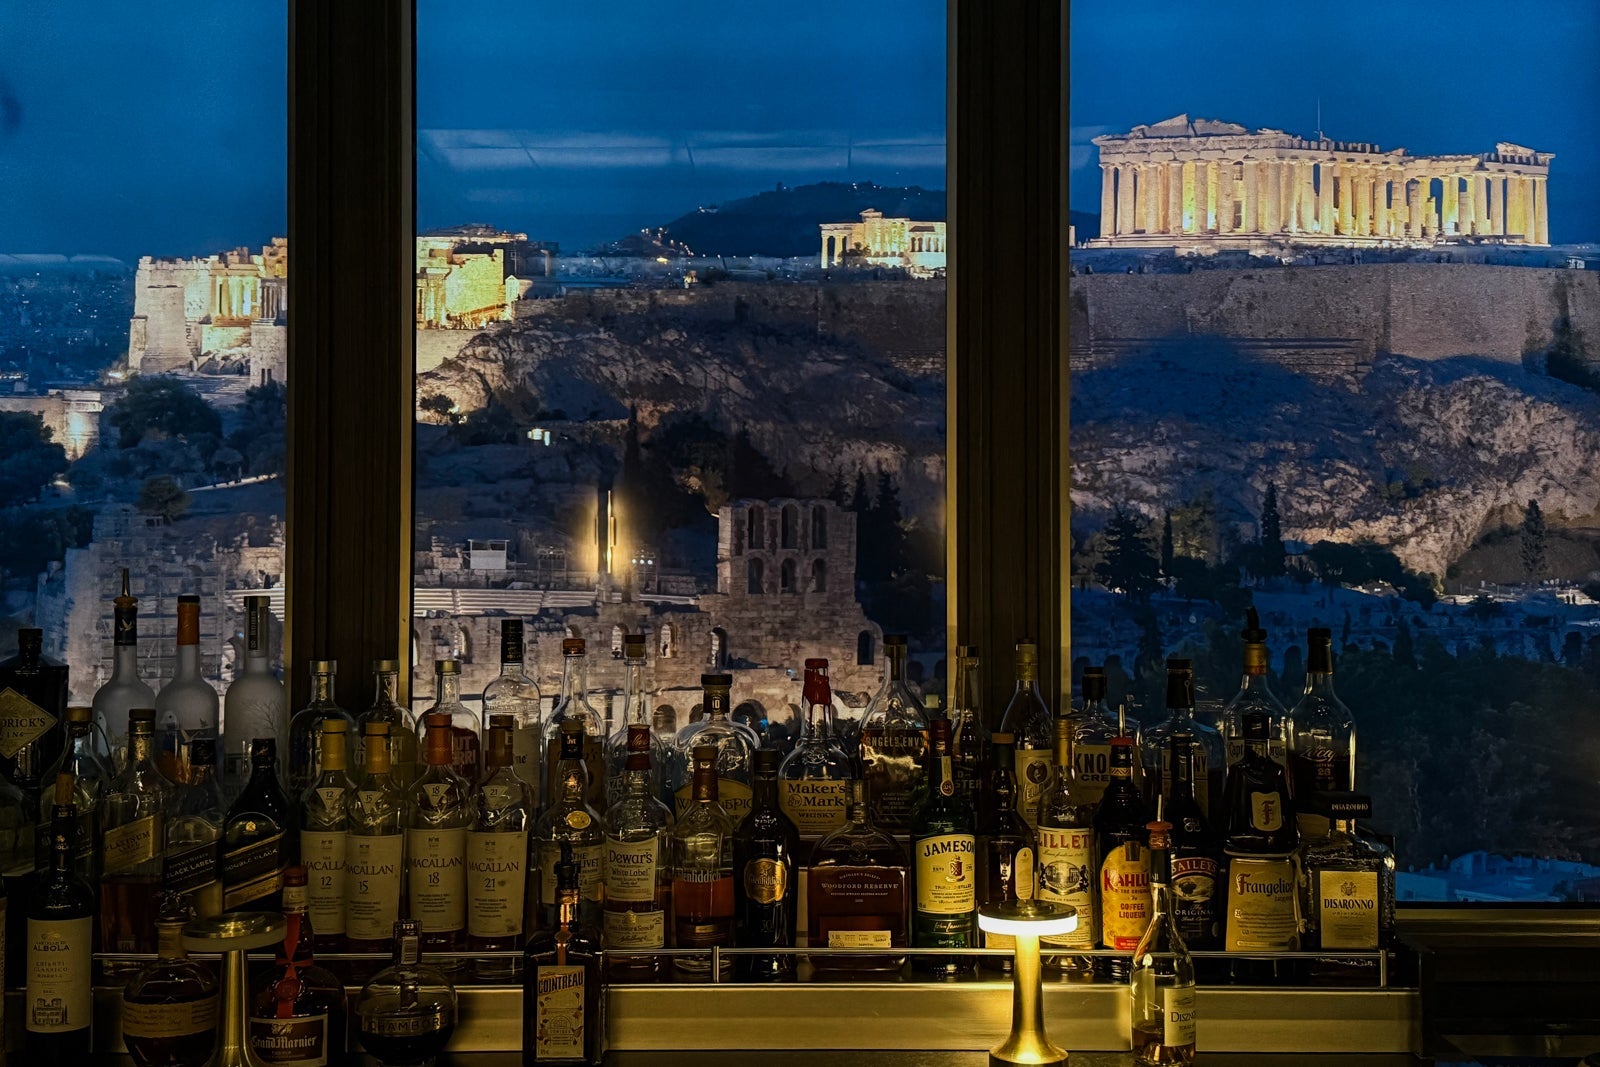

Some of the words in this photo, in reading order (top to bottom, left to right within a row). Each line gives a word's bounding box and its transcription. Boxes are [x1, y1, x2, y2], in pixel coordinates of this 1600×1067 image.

[711, 698, 721, 709] 10
[1075, 753, 1107, 775] KNO
[1081, 774, 1109, 782] CRE
[325, 790, 334, 798] 12
[432, 786, 440, 794] 18
[489, 788, 498, 796] 21
[787, 783, 847, 794] Maker's
[803, 795, 845, 807] Mark
[409, 857, 463, 868] MACALLAN
[609, 850, 653, 864] Dewar's
[302, 861, 346, 871] MACALLA
[469, 861, 519, 873] MACALLAN
[1171, 860, 1217, 874] BAILEYS
[429, 872, 440, 884] 18
[629, 868, 649, 877] Label
[320, 876, 332, 886] 12
[484, 878, 496, 888] 21
[1103, 868, 1150, 892] KAHLÚ
[359, 880, 369, 893] 15
[1120, 903, 1145, 911] COFFEE
[1323, 898, 1374, 910] DISARONNO
[1118, 911, 1146, 919] LIQUEUR
[539, 971, 583, 994] COINTREAU
[367, 1016, 448, 1034] CHAMBORD
[251, 1037, 276, 1050] Grand
[275, 1035, 318, 1049] Marnier
